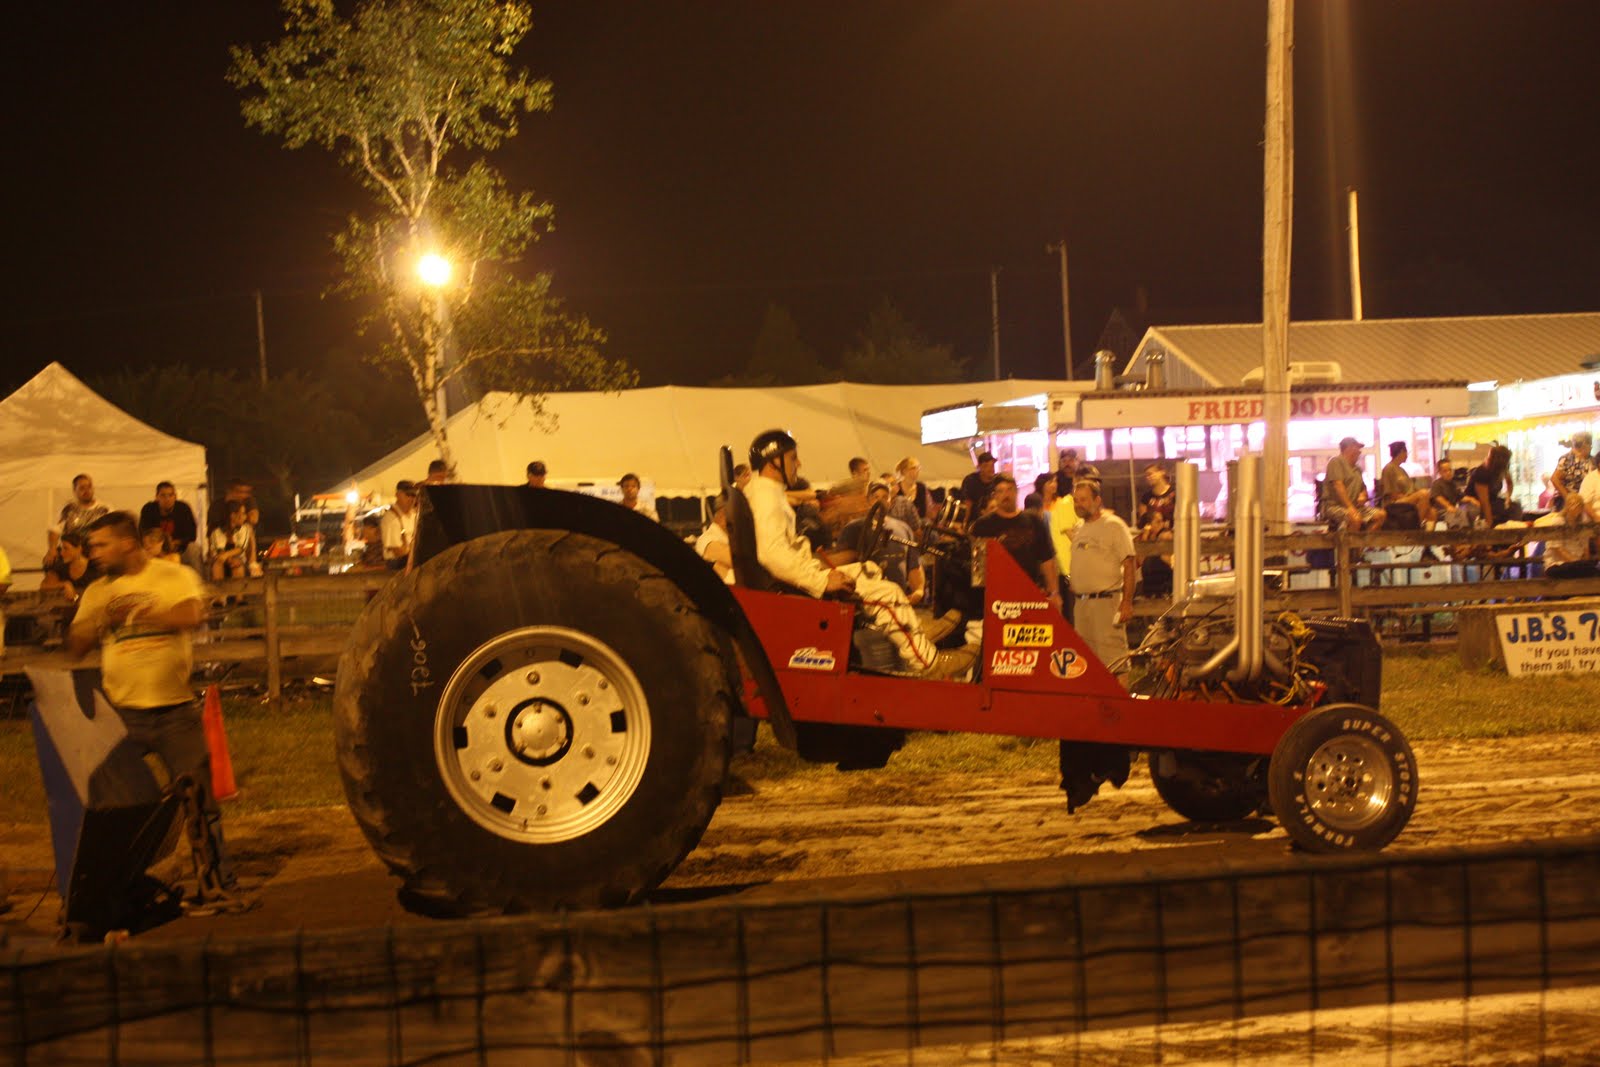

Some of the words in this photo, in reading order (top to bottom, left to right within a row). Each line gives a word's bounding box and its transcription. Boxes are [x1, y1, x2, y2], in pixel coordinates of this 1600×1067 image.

[1188, 399, 1263, 420] FRIED
[1019, 626, 1046, 635] Auto
[1506, 615, 1575, 643] J.B.S.
[1016, 634, 1050, 644] Meter
[995, 651, 1035, 665] MSD
[1546, 648, 1569, 659] you
[1574, 646, 1600, 656] have
[1053, 650, 1076, 676] VP
[1520, 662, 1552, 672] them
[1556, 659, 1574, 671] all,
[1579, 659, 1596, 670] try
[1343, 719, 1391, 742] SUPER
[1395, 752, 1410, 806] STOCK
[1296, 794, 1354, 847] FORMULA
